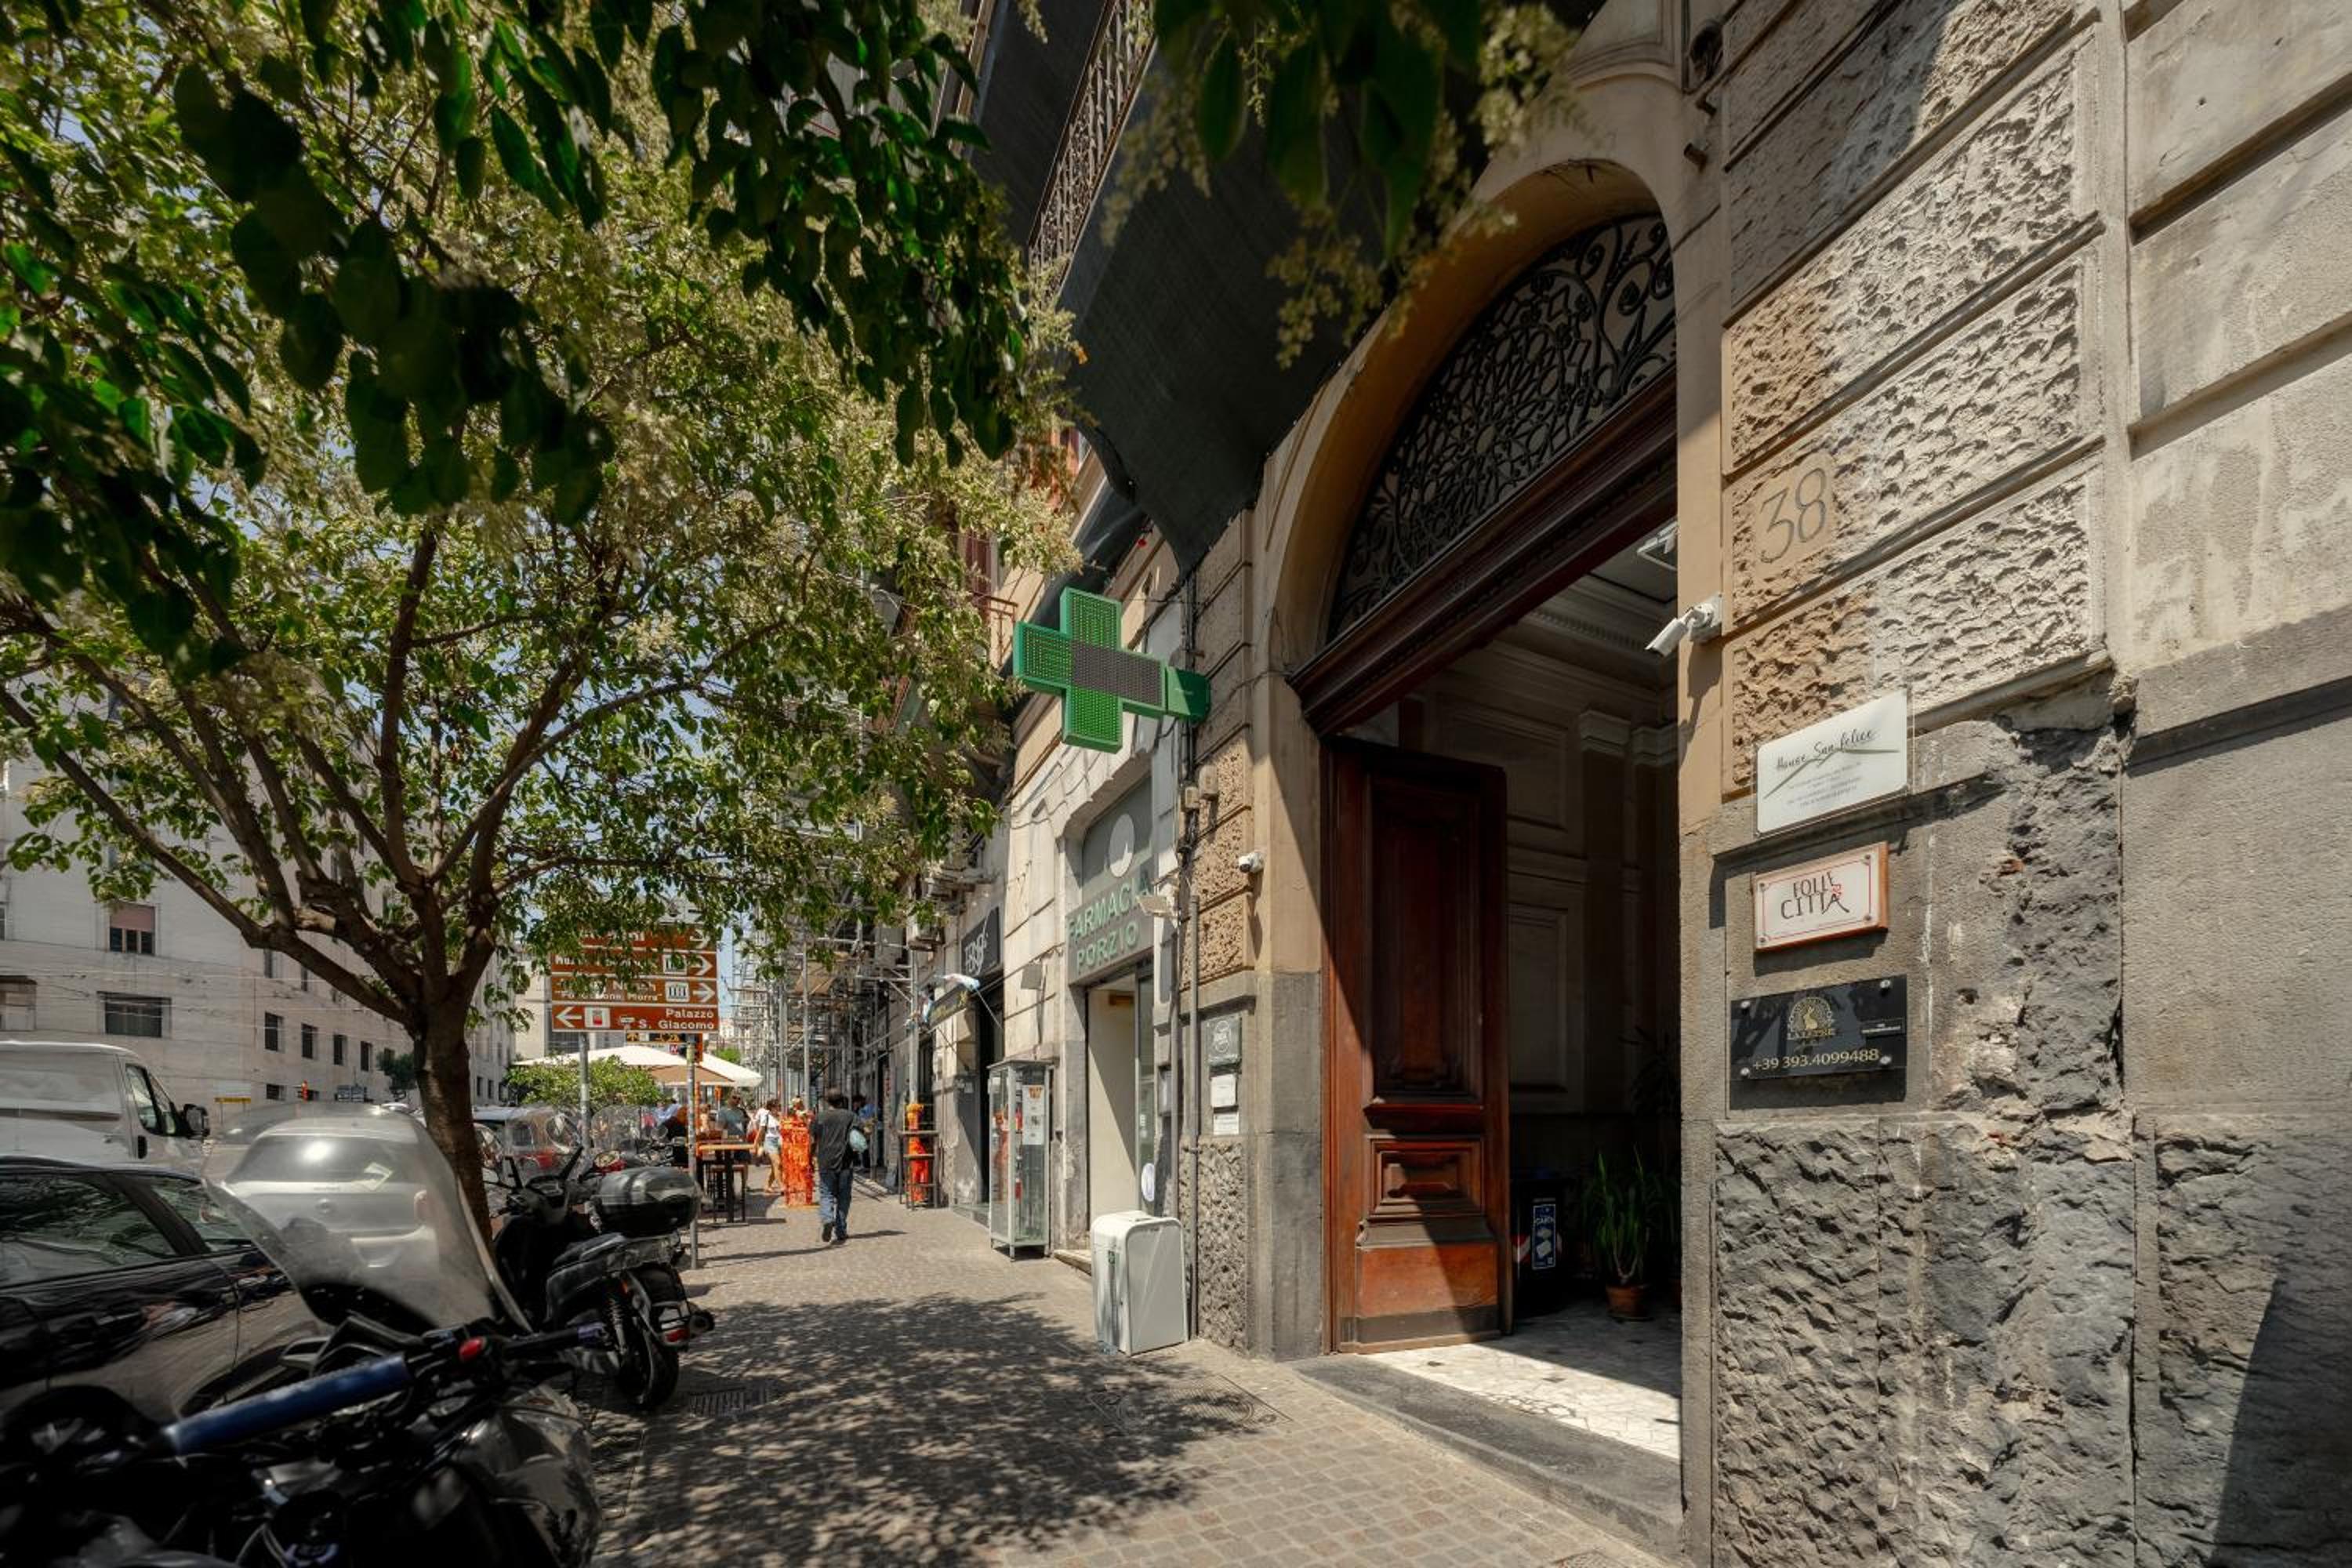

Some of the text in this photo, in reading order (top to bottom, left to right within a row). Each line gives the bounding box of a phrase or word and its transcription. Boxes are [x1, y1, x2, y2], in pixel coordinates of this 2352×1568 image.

[1760, 467, 1827, 564] 38
[1813, 741, 1834, 757] San
[1069, 877, 1152, 943] FARMACIA
[1077, 921, 1139, 973] PORZIO
[638, 1019, 714, 1029] S. Giacomo
[666, 1008, 714, 1018] Palazzo
[1752, 1048, 1880, 1070] +39 393.4099488
